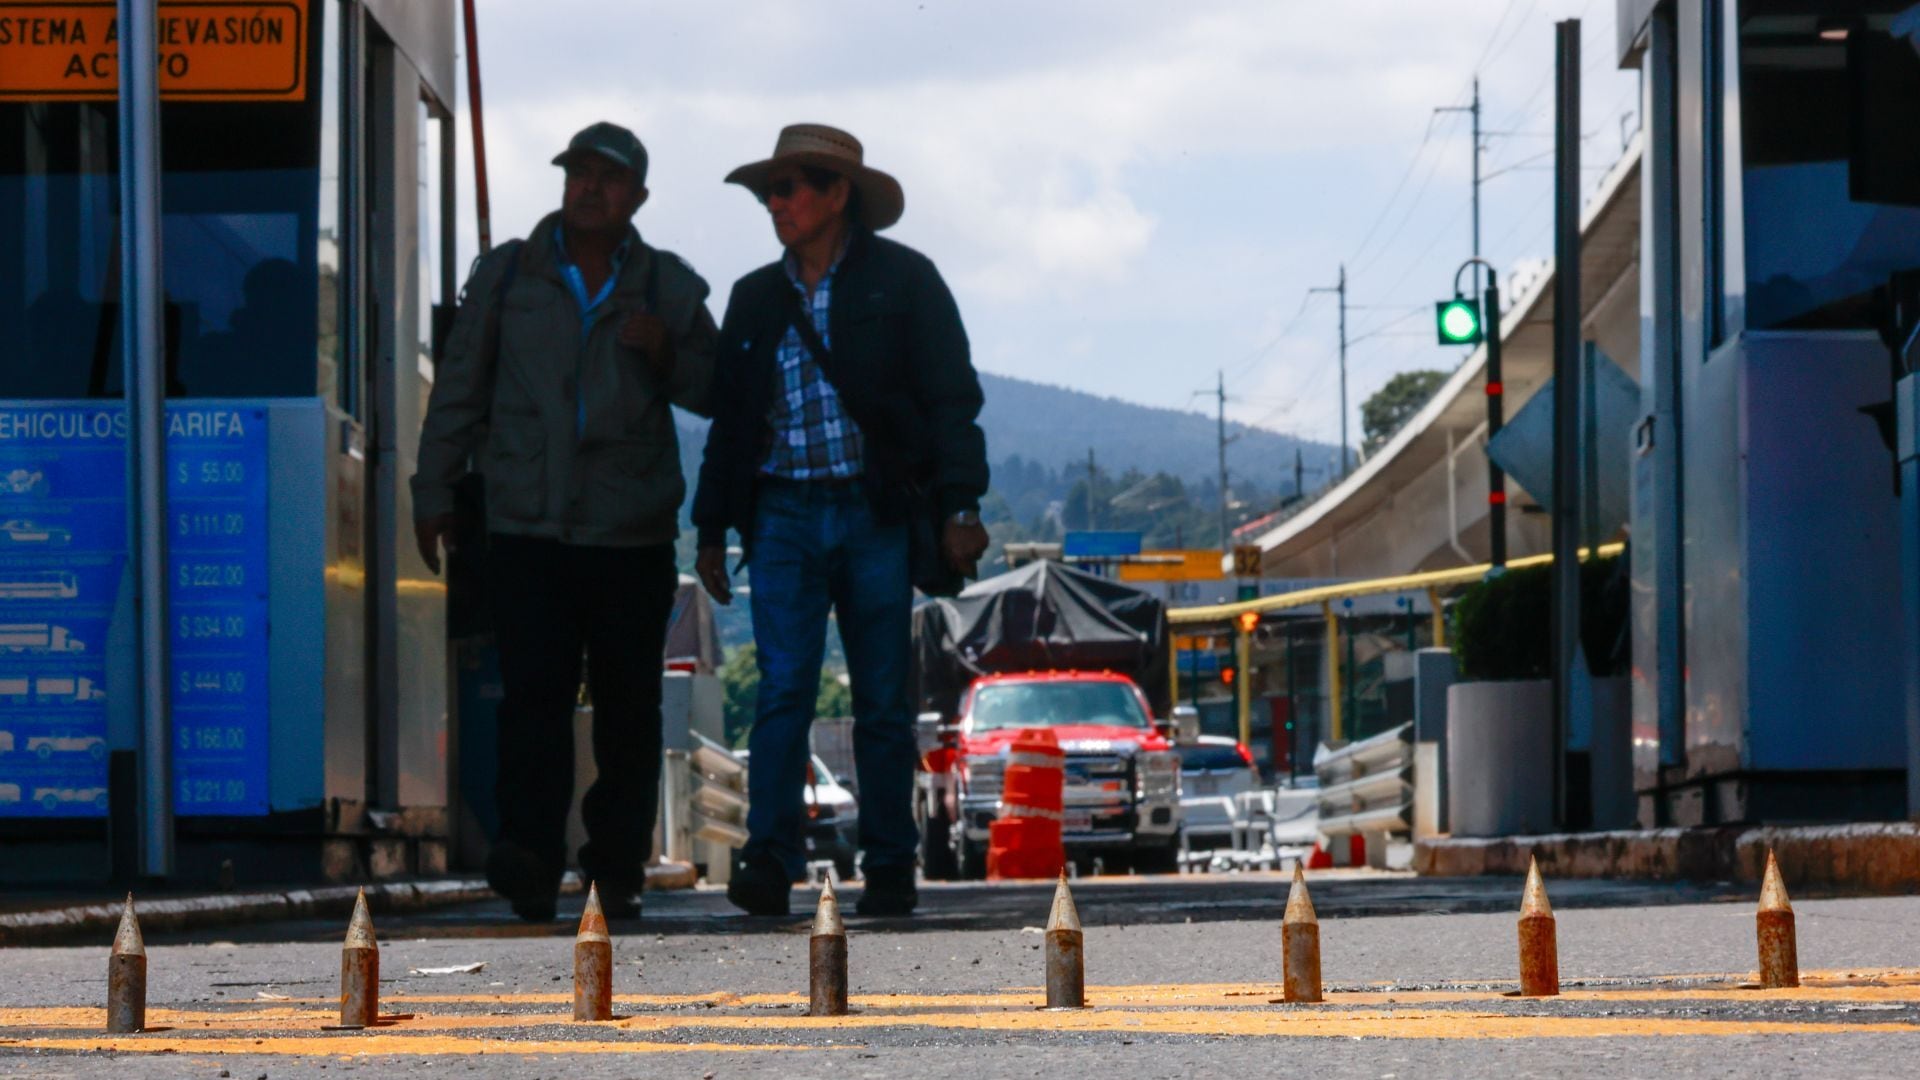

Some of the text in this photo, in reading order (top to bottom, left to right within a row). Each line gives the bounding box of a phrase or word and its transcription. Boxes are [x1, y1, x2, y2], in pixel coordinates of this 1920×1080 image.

[104, 10, 283, 45] AIEVASIÓN
[63, 53, 189, 79] ACO
[164, 412, 244, 437] ARIFA
[178, 461, 188, 484] $
[179, 513, 243, 535] $ 111.00
[1236, 548, 1259, 574] 32
[180, 564, 243, 587] $ 222.00
[180, 615, 189, 638] $
[180, 671, 244, 693] $ 444.00
[180, 726, 190, 749] $
[180, 779, 190, 802] $
